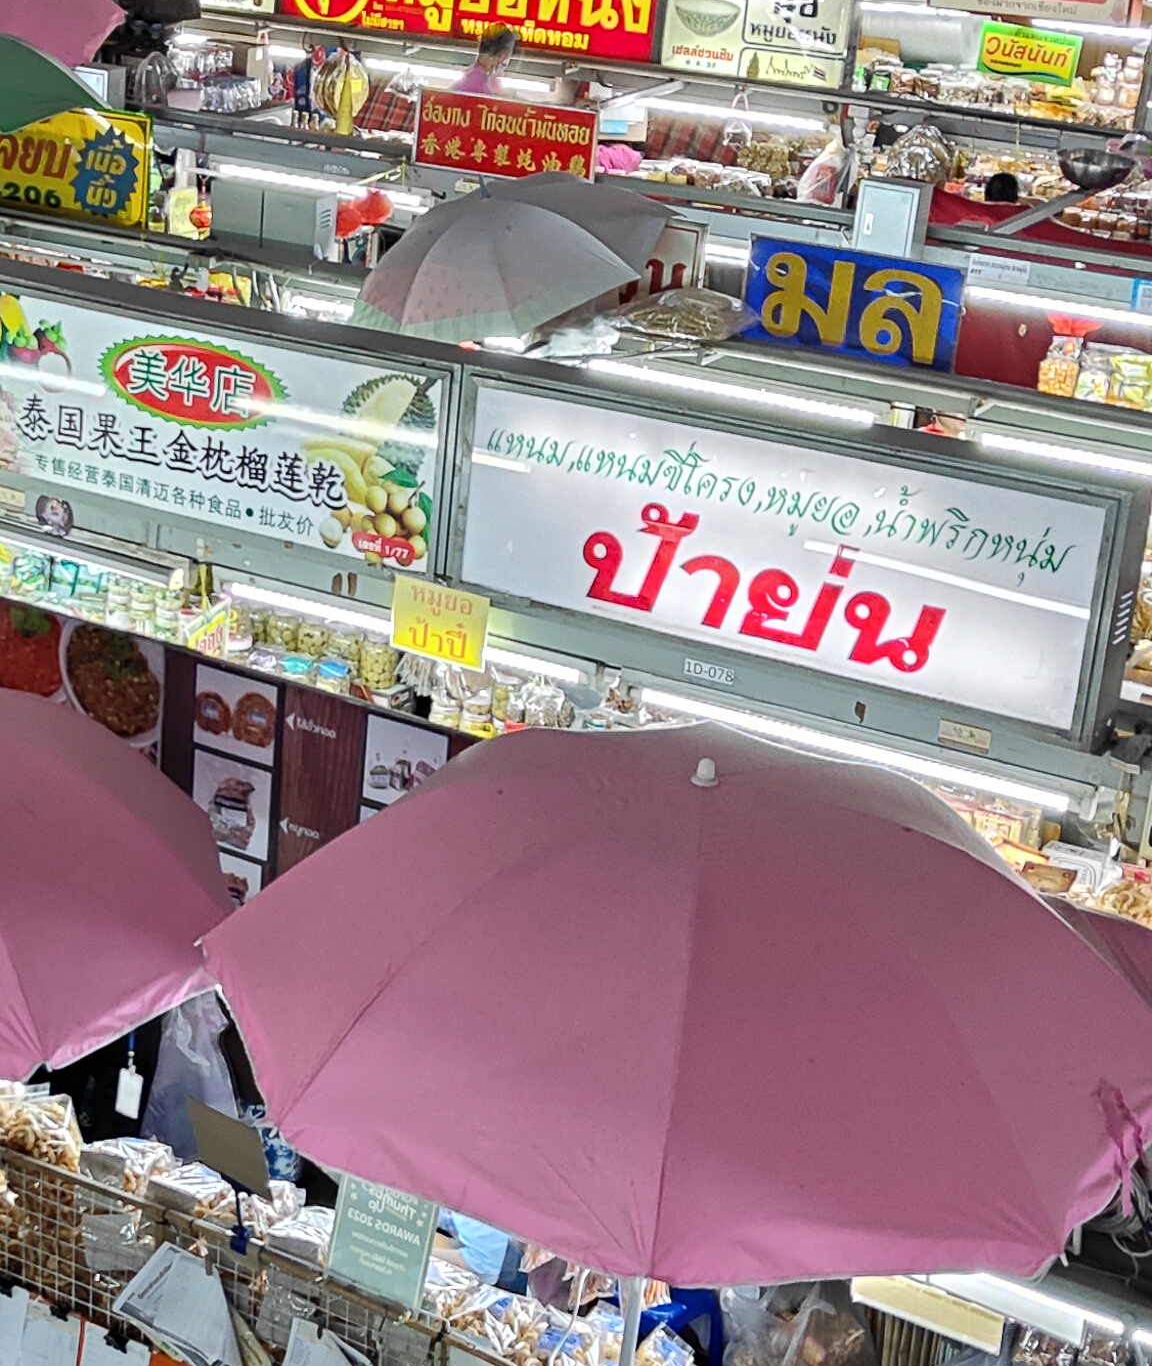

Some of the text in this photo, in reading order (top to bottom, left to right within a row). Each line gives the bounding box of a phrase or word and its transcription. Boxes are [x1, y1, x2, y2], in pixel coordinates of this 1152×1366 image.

[985, 37, 1072, 68] วนัสนันท์
[761, 252, 943, 365] มล
[126, 349, 256, 417] 美华店
[411, 585, 472, 617] หมูยอ
[582, 502, 947, 674] ป้าย่น
[686, 659, 734, 682] 1D-078
